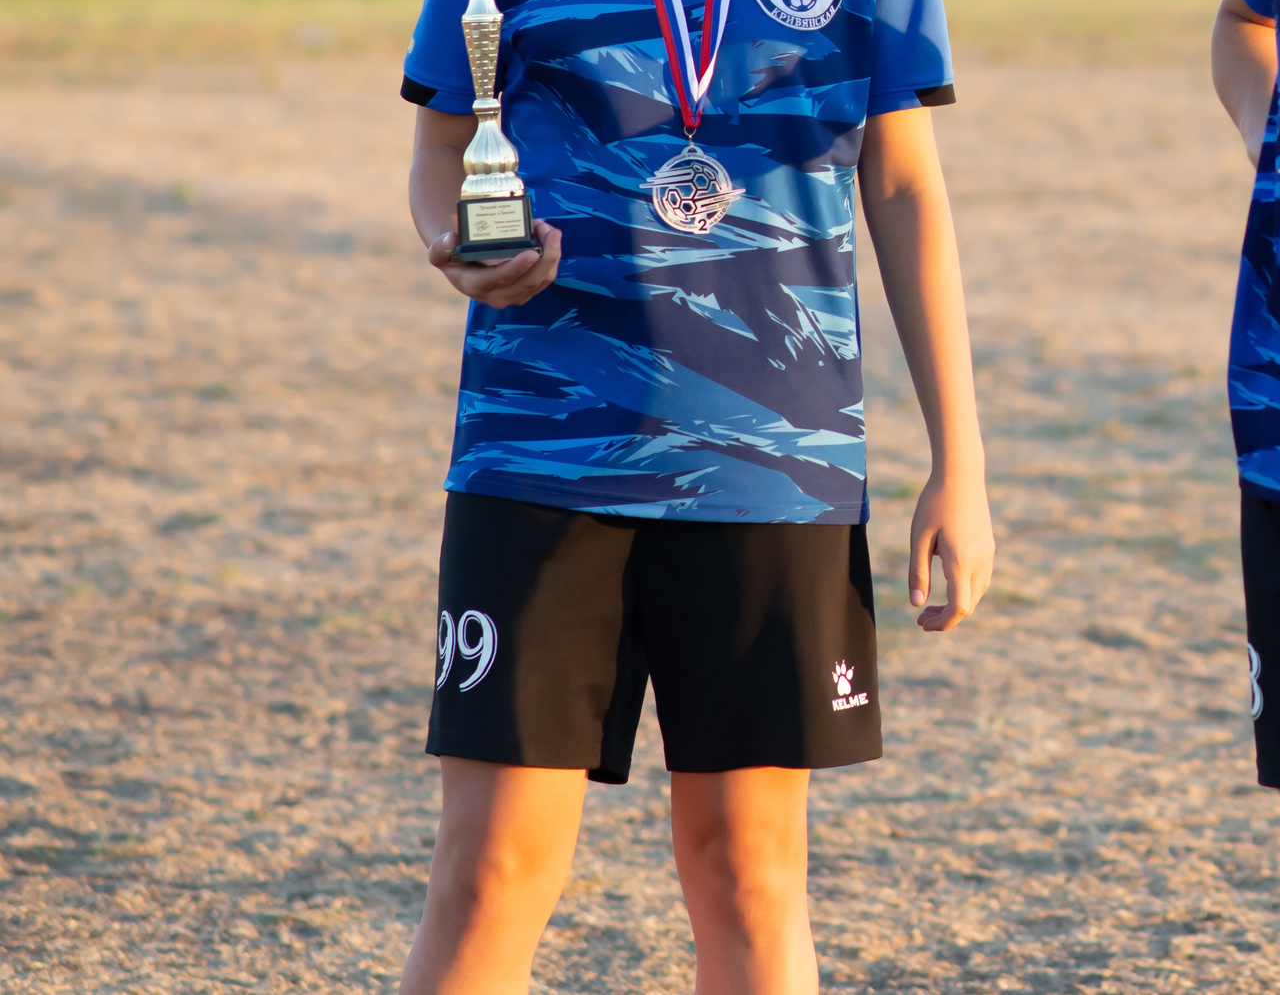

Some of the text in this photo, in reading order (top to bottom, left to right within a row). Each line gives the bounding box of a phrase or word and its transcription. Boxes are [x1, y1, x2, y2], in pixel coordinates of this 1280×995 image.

[771, 5, 836, 28] КРИВЯНСКАЯ
[698, 218, 708, 231] 2
[436, 610, 498, 693] 99
[832, 692, 869, 711] KELME
